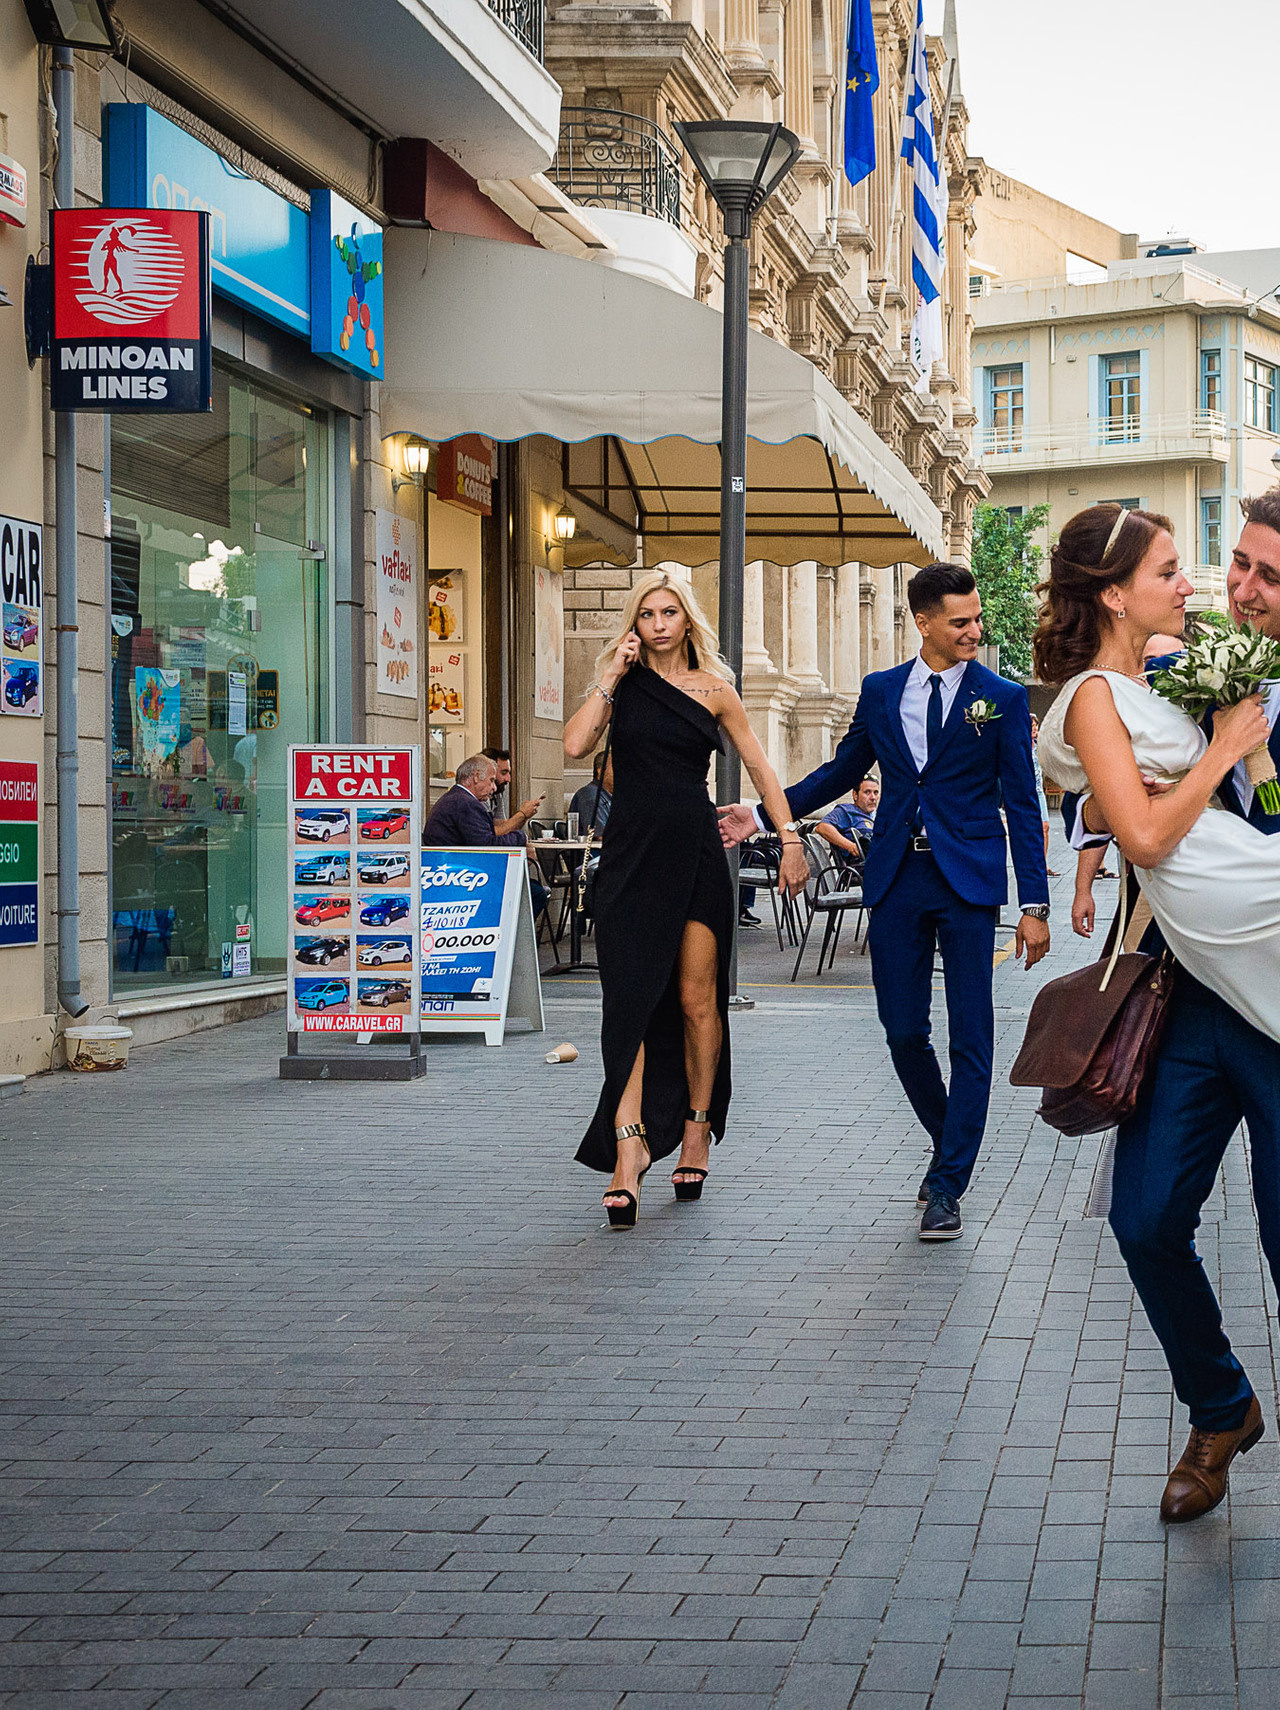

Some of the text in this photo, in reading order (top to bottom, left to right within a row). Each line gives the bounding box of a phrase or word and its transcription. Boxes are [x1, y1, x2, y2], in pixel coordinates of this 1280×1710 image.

[60, 346, 194, 371] MINOAN
[82, 376, 168, 399] LINES
[457, 451, 491, 485] DONUTS
[1, 523, 41, 608] CAR
[311, 755, 395, 773] RENT
[304, 777, 402, 796] A CAR
[423, 905, 476, 916] ΤΖΑΚΠΟΤ
[305, 1016, 401, 1031] WWW.CARAVEL.GR
